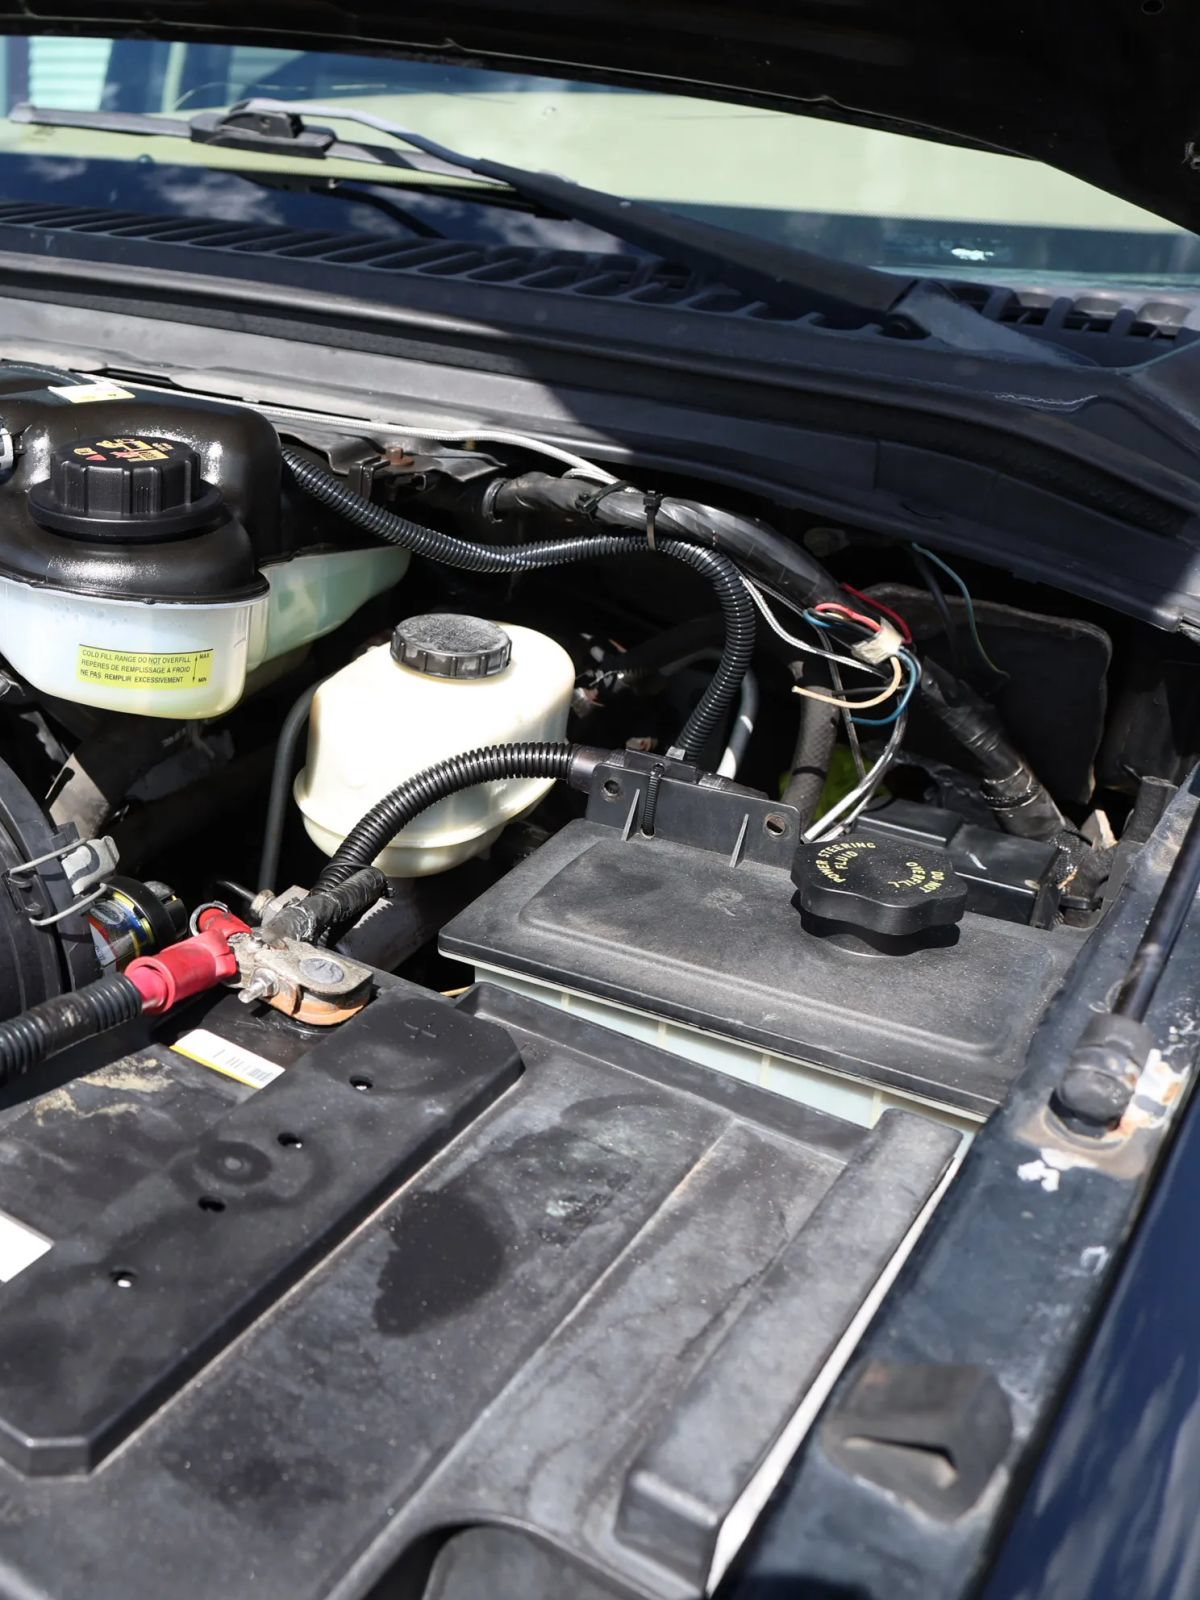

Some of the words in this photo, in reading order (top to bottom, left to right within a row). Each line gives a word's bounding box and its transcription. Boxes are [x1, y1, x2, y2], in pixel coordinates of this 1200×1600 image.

[82, 649, 100, 659] COLD
[100, 652, 113, 661] FILL
[114, 654, 137, 664] RANGE
[137, 656, 148, 664] DO
[148, 657, 161, 665] NOT
[161, 656, 192, 664] OVERFILL
[80, 668, 90, 676] NE
[90, 670, 102, 679] PAS
[104, 672, 132, 682] REMPLIR
[134, 675, 184, 684] EXCESSIVEMENT
[110, 663, 120, 672] DE
[120, 665, 166, 674] REMPLISSAGE
[172, 665, 191, 673] FROID
[818, 841, 877, 858] STEERING
[833, 850, 859, 870] FLUID
[815, 859, 847, 883] POWER
[887, 861, 926, 889] OVERFILL
[930, 870, 945, 880] DO
[919, 880, 943, 893] NOT
